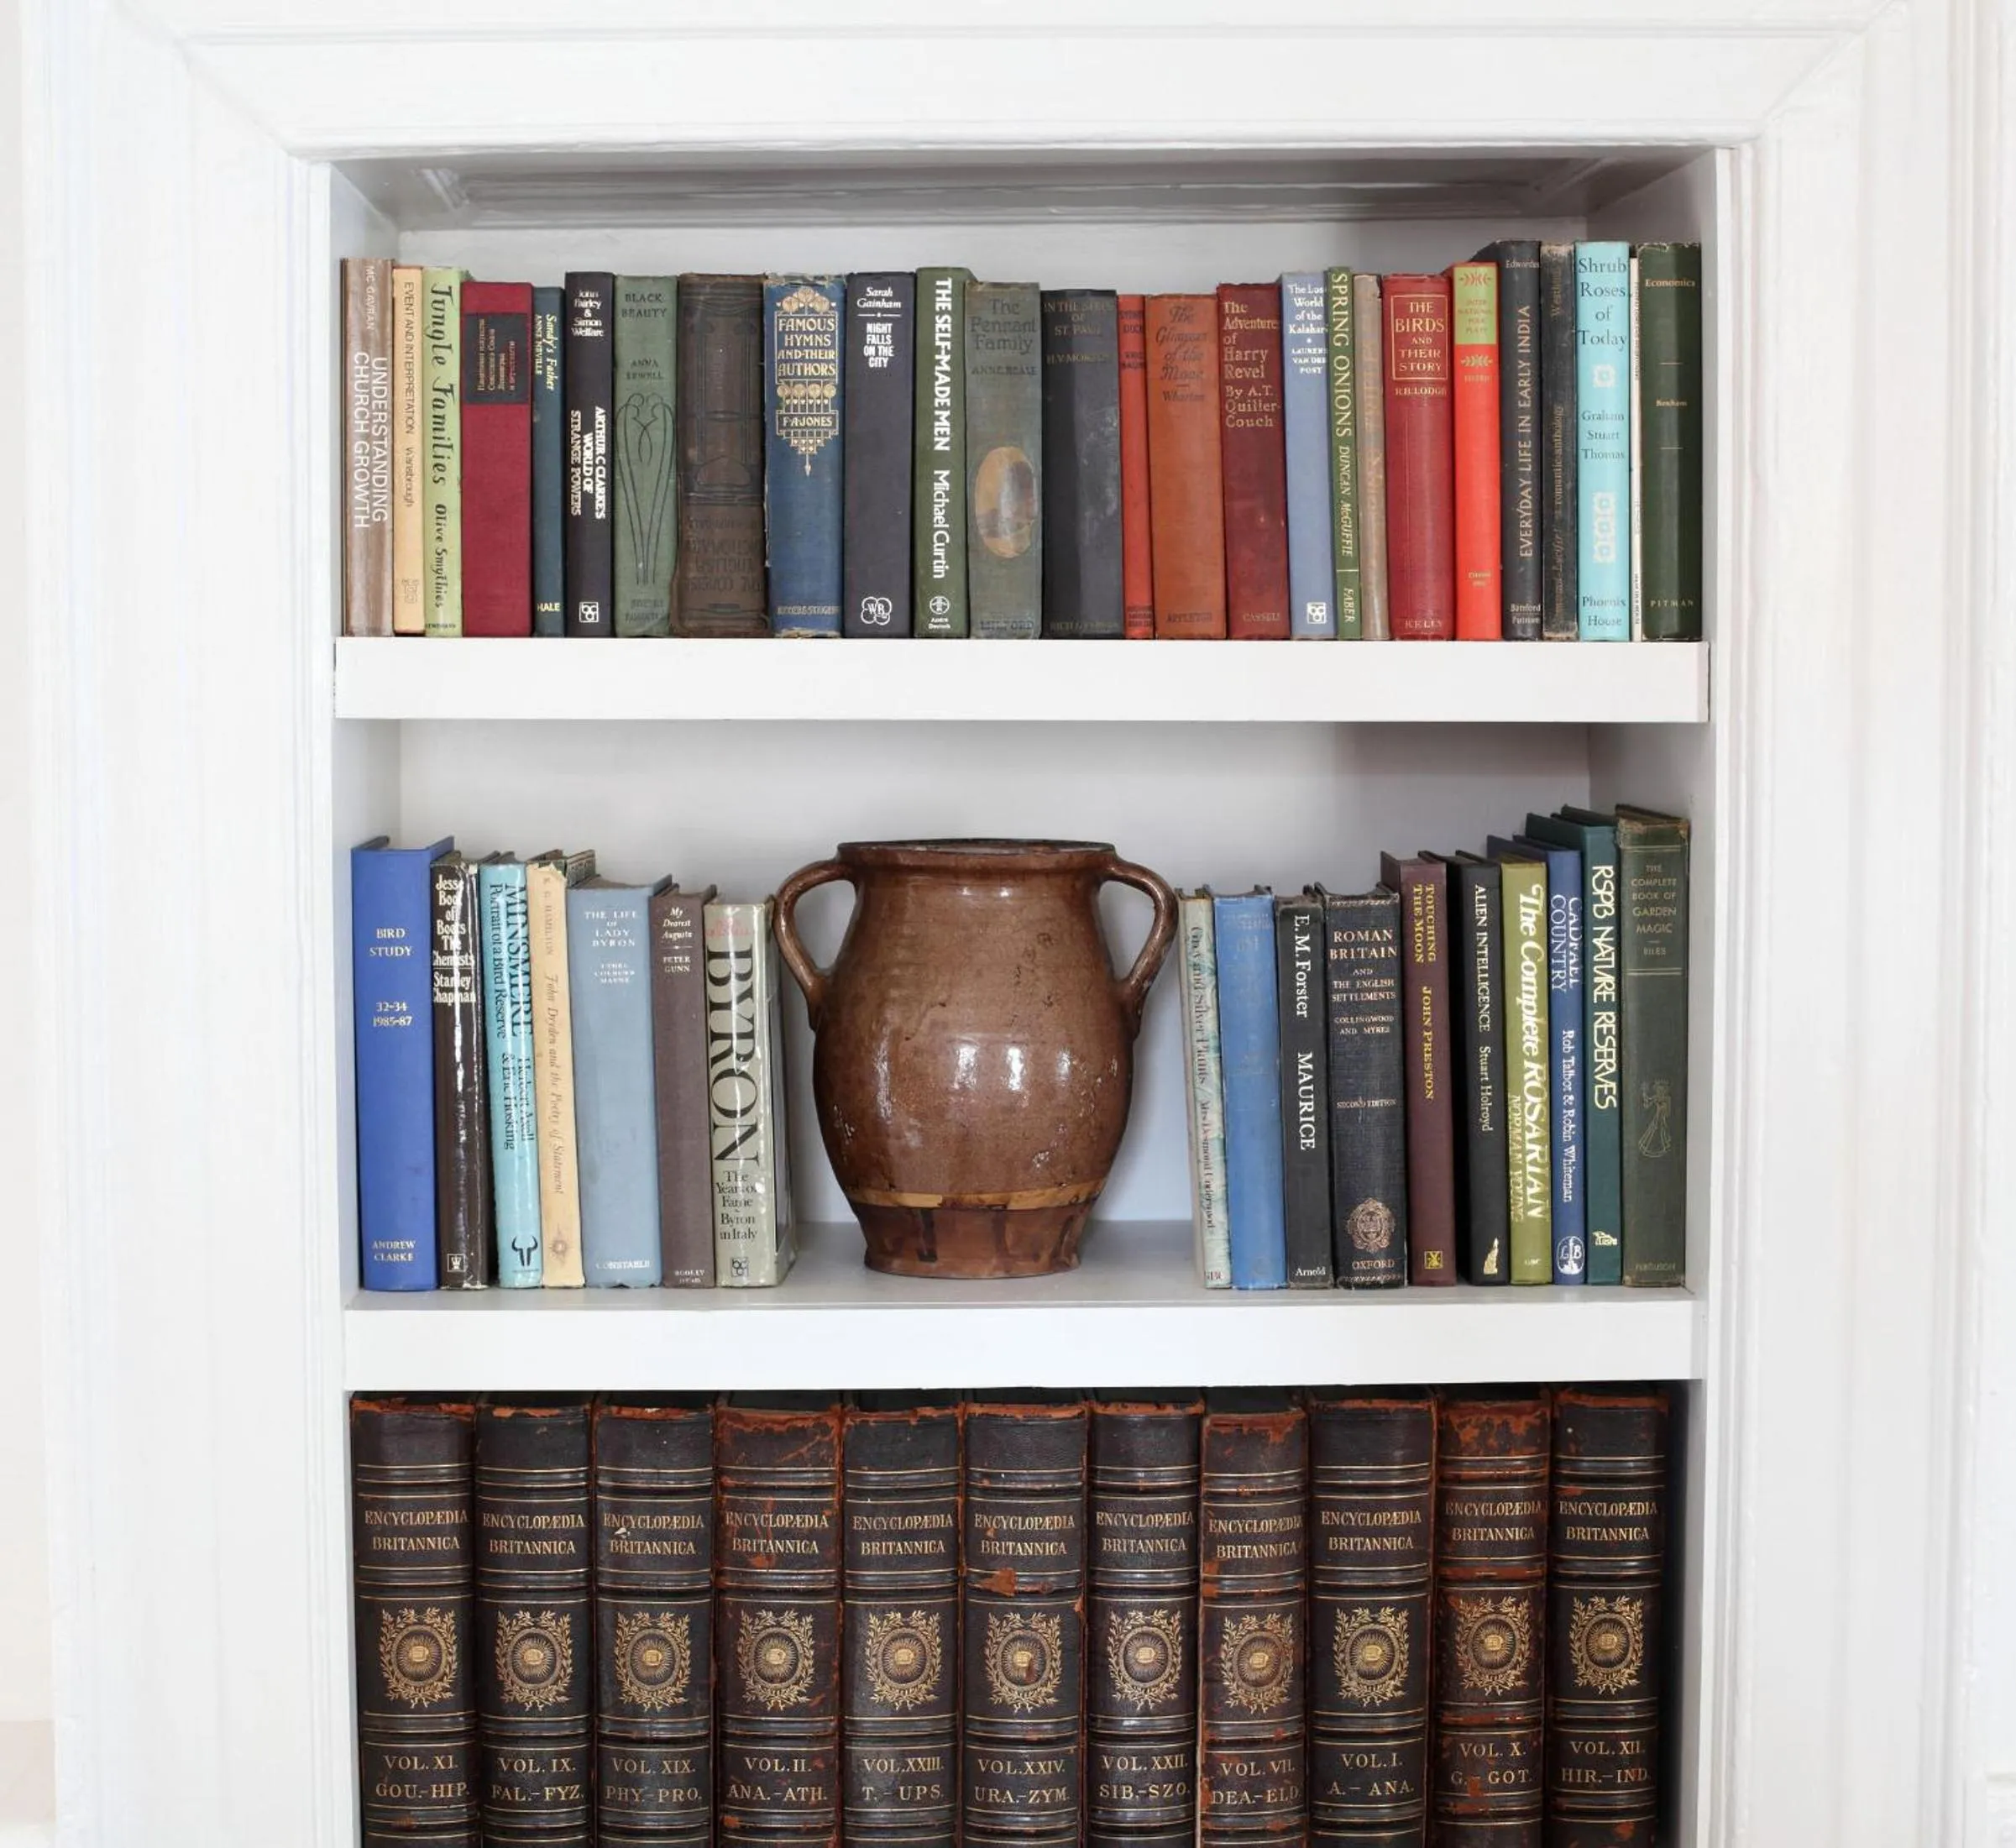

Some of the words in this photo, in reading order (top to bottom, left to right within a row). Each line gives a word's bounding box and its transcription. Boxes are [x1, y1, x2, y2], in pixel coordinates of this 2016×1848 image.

[1579, 258, 1627, 274] Shrub
[1289, 285, 1305, 294] The
[1580, 282, 1626, 297] Roses
[1645, 279, 1695, 288] Economics
[626, 294, 663, 303] BLACK
[866, 287, 893, 296] Sarah
[935, 278, 952, 311] THE
[856, 298, 902, 308] Gainham
[991, 299, 1020, 315] The
[1224, 302, 1248, 313] The
[1294, 298, 1323, 307] World
[1409, 302, 1433, 312] THE
[622, 308, 667, 318] BEAUTY
[1296, 311, 1305, 321] of
[1306, 311, 1322, 320] the
[1332, 274, 1350, 347] SPRING
[1595, 306, 1613, 322] of
[427, 283, 452, 365] Jungle
[573, 318, 601, 327] Simon
[778, 318, 835, 331] FAMOUS
[866, 323, 893, 334] NIGHT
[1395, 318, 1444, 332] BIRDS
[1518, 306, 1531, 353] INDIA
[545, 314, 557, 353] Sandy's
[785, 335, 831, 347] HYMNS
[866, 335, 892, 344] FALLS
[1223, 333, 1237, 344] of
[1578, 330, 1627, 351] Today
[863, 346, 877, 357] ON
[877, 345, 894, 356] THE
[975, 336, 1033, 353] Family
[935, 313, 951, 407] SELF-MADE
[1224, 348, 1269, 361] Harry
[1400, 349, 1441, 359] THEIR
[778, 363, 835, 376] AUTHORS
[868, 357, 888, 367] CITY
[1400, 363, 1441, 372] STORY
[546, 357, 558, 390] Father
[1224, 364, 1265, 378] Revel
[1518, 360, 1531, 407] EARLY
[353, 352, 369, 433] CHURCH
[1333, 356, 1352, 437] ONIONS
[1226, 416, 1273, 427] Couch
[1518, 415, 1531, 432] IN
[1582, 411, 1625, 421] Graham
[432, 377, 456, 484] Families
[571, 410, 581, 464] STRANGE
[934, 412, 950, 451] MEN
[1586, 431, 1619, 440] Stuart
[371, 357, 388, 522] UNDERSTANDING
[583, 432, 593, 474] WORLD
[1519, 441, 1532, 472] LIFE
[1581, 449, 1625, 460] Thomas
[1339, 446, 1351, 495] DUNCAN
[353, 441, 370, 528] GROWTH
[571, 467, 581, 516] POWERS
[583, 478, 593, 494] OF
[933, 470, 950, 527] Michael
[433, 505, 447, 542] Olive
[1520, 478, 1532, 558] EVERYDAY
[1341, 501, 1353, 557] McGUFFIE
[933, 531, 949, 578] Curtin
[433, 547, 448, 608] Smythies
[537, 603, 560, 611] HALE
[1343, 588, 1355, 622] FABER
[1582, 596, 1626, 608] Phoenix
[1588, 616, 1622, 626] House
[1631, 878, 1677, 887] COMPLETE
[1414, 884, 1423, 910] THE
[1592, 865, 1614, 919] RSPB
[1632, 893, 1659, 901] BOOK
[1663, 892, 1676, 900] OF
[1475, 885, 1486, 927] ALIEN
[1518, 884, 1545, 937] The
[1632, 907, 1677, 917] GARDEN
[1426, 884, 1436, 962] TOUCHING
[1636, 924, 1673, 934] MAGIC
[376, 929, 406, 939] BIRD
[1333, 929, 1393, 943] ROMAN
[1414, 916, 1425, 963] MOON
[1550, 894, 1566, 992] COUNTRY
[369, 946, 413, 956] STUDY
[1329, 945, 1397, 960] BRITAIN
[505, 884, 532, 1036] MINSMERE
[1592, 926, 1615, 1003] NATURE
[1333, 981, 1350, 989] THE
[1356, 979, 1395, 988] ENGLISH
[1476, 931, 1490, 1032] INTELLIGENCE
[1332, 992, 1395, 1002] SETTLEMENTS
[1518, 940, 1547, 1056] Complete
[376, 1003, 407, 1011] 32-34
[1422, 987, 1432, 1026] JOHN
[373, 1016, 412, 1027] 1985-87
[1334, 1015, 1394, 1023] COLLINGWOOD
[1562, 1030, 1574, 1053] Rob
[707, 944, 760, 1168] BYRON
[1594, 1011, 1617, 1109] RESERVES
[1423, 1030, 1434, 1099] PRESTON
[1479, 1046, 1491, 1083] Stuart
[1562, 1056, 1574, 1092] Talbot
[1297, 1052, 1316, 1150] MAURICE
[1562, 1094, 1574, 1105] &
[1481, 1086, 1494, 1132] Holroyd
[1562, 1108, 1574, 1142] Robin
[1522, 1061, 1549, 1221] ROSARIAN
[723, 1170, 749, 1182] The
[1562, 1145, 1575, 1202] Whiteman
[720, 1213, 755, 1227] Byron
[720, 1229, 730, 1239] in
[731, 1228, 757, 1241] Italy
[372, 1240, 416, 1249] ANDREW
[374, 1253, 413, 1262] CLARKE
[1352, 1259, 1395, 1270] OXFORD
[1296, 1266, 1326, 1276] Arnold
[364, 1510, 468, 1525] ENCYCLOPÆDIA
[483, 1513, 584, 1529] ENCYCLOPÆDIA
[604, 1513, 704, 1529] ENCYCLOPÆDIA
[725, 1512, 829, 1529] ENCYCLOPÆDIA
[853, 1513, 953, 1530] ENCYCLOPÆDIA
[975, 1513, 1076, 1530] ENCYCLOPÆDIA
[1096, 1510, 1194, 1527] ENCYCLOPÆDIA
[1209, 1515, 1303, 1533] ENCYCLOPÆDIA
[1322, 1510, 1422, 1526] ENCYCLOPÆDIA
[1452, 1527, 1535, 1541] BRITANNICA
[1566, 1527, 1649, 1541] BRITANNICA
[373, 1537, 460, 1550] BRITANNICA
[490, 1541, 575, 1554] BRITANNICA
[610, 1541, 696, 1555] BRITANNICA
[732, 1540, 819, 1554] BRITANNICA
[861, 1541, 945, 1555] BRITANNICA
[981, 1542, 1067, 1555] BRITANNICA
[1102, 1537, 1188, 1552] BRITANNICA
[1217, 1542, 1298, 1558] BRITANNICA
[1328, 1537, 1414, 1551] BRITANNICA
[1460, 1742, 1503, 1757] VOL.
[1510, 1741, 1526, 1756] X.
[500, 1758, 544, 1773] VOL.
[550, 1758, 576, 1772] IX.
[613, 1758, 656, 1773] VOL.
[662, 1759, 696, 1773] XIX.
